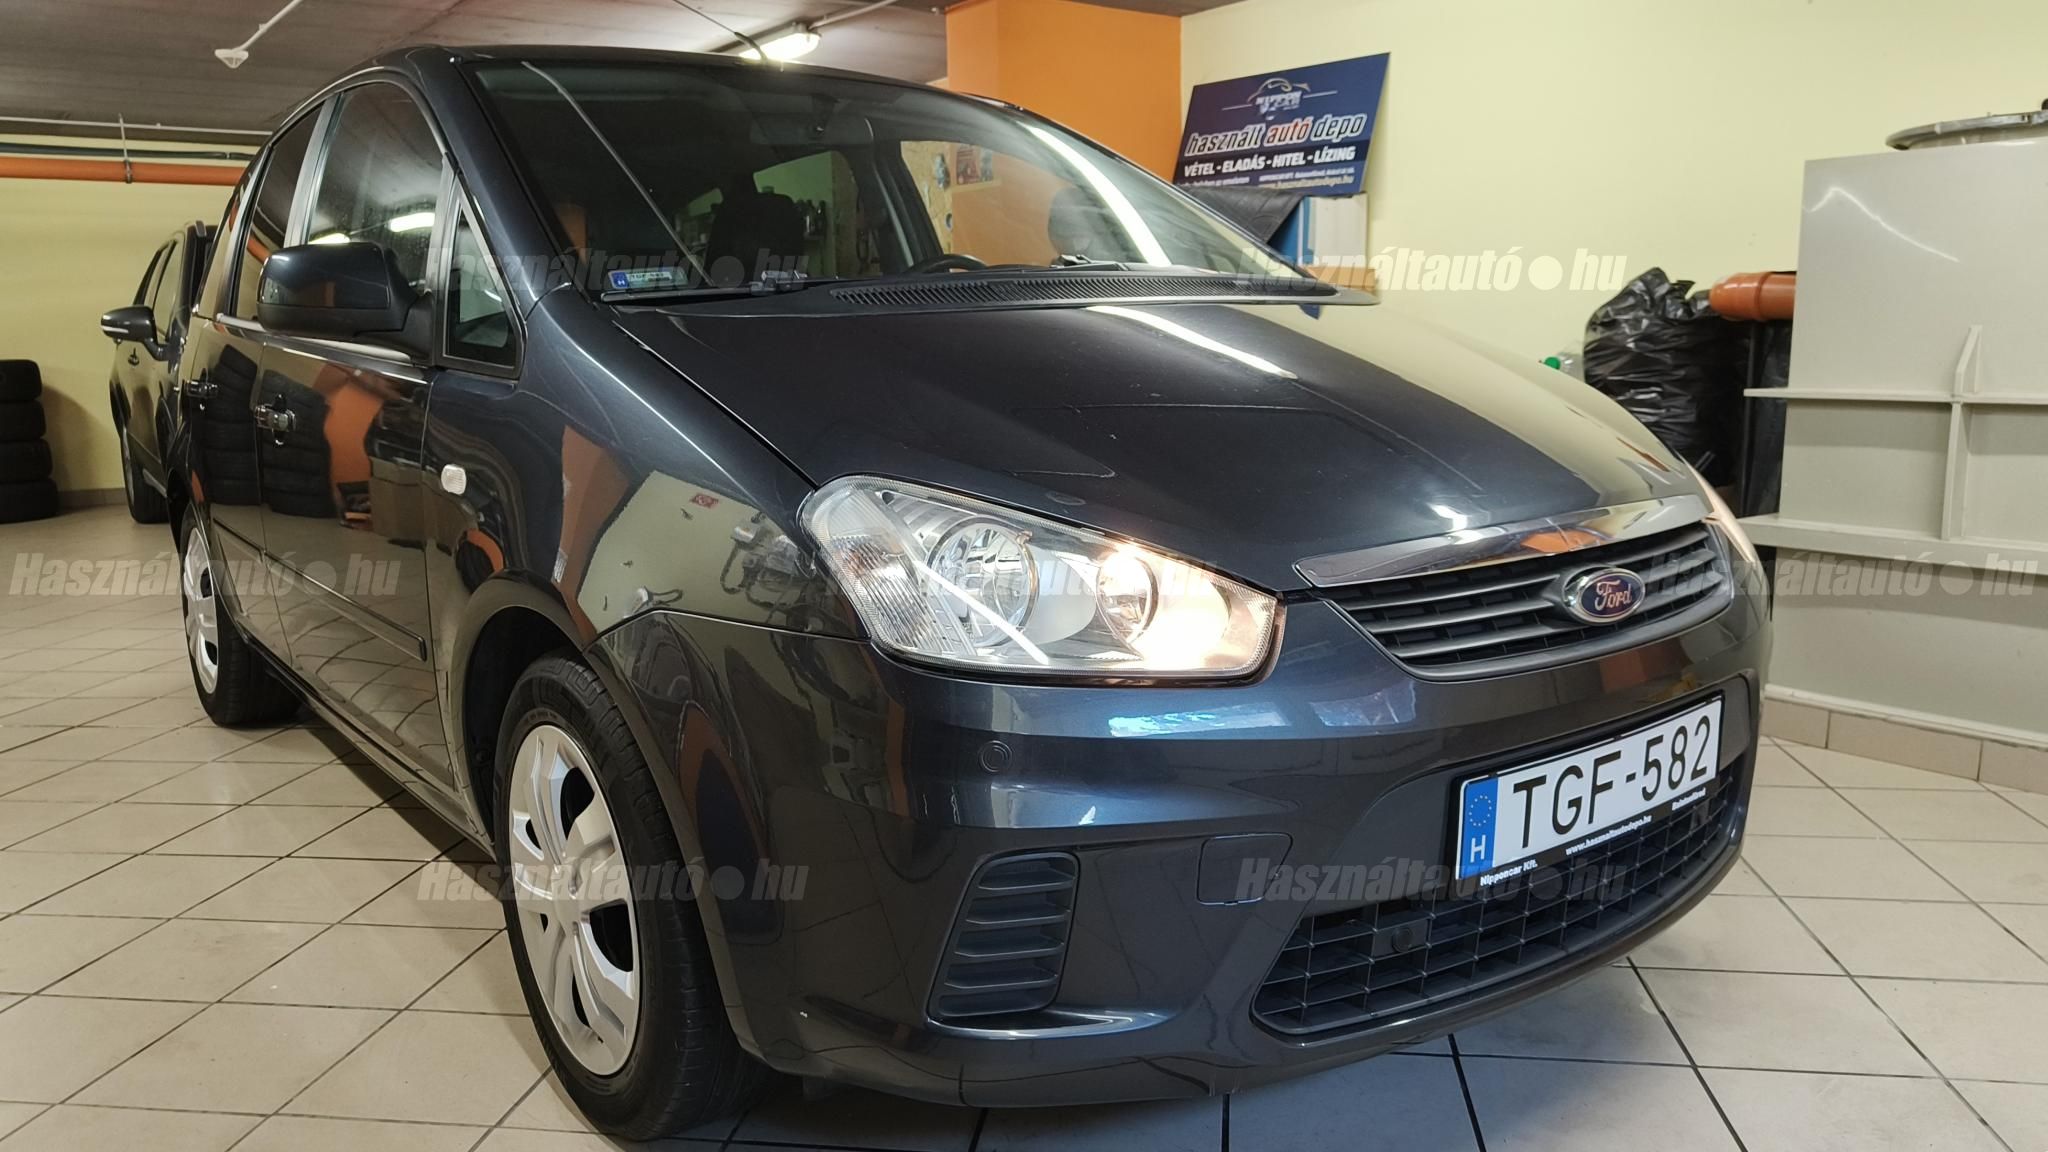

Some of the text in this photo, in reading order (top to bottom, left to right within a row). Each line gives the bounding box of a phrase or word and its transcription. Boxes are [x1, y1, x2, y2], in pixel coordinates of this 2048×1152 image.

[1184, 112, 1368, 156] használt autó depo
[1184, 146, 1356, 177] VÉTEL ELADÁS HITEL LÍZING
[1594, 580, 1633, 611] Ford
[1513, 715, 1711, 849] TGF-582
[1470, 835, 1486, 863] H
[1480, 859, 1538, 887] Nipponcar Kft.
